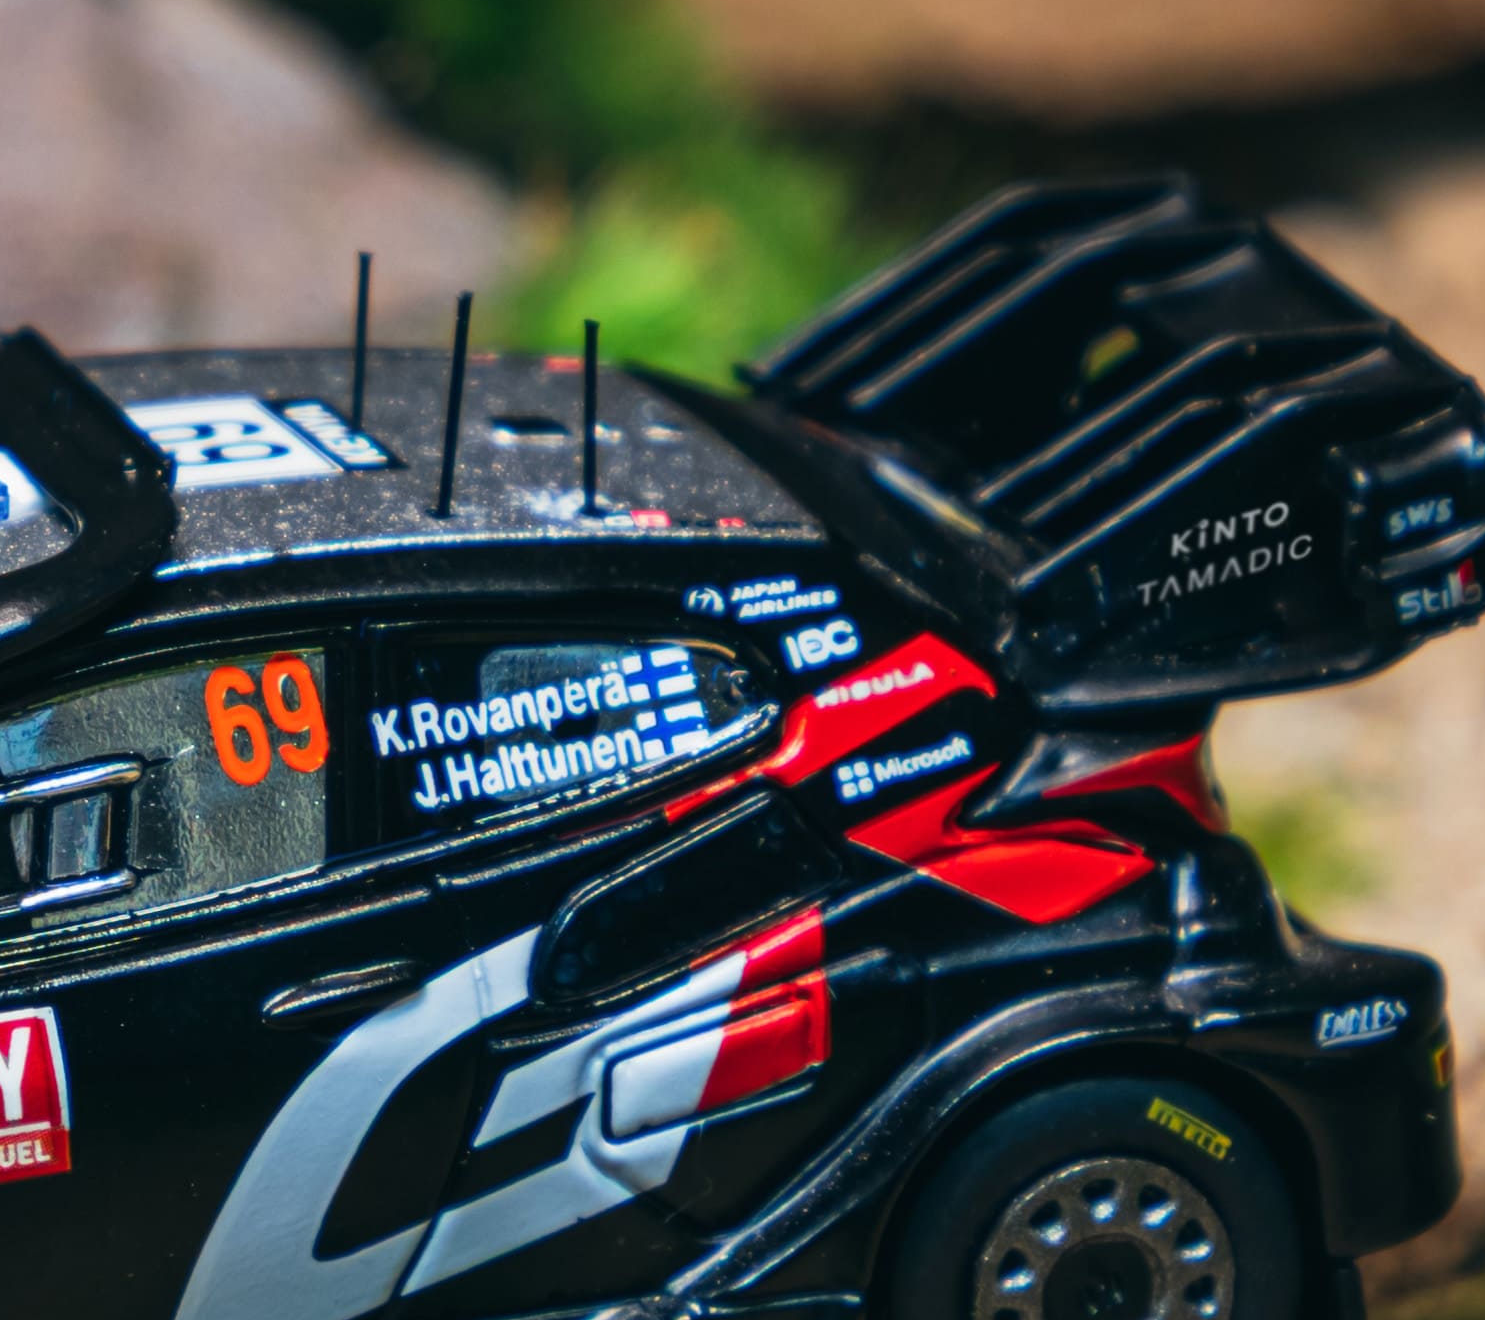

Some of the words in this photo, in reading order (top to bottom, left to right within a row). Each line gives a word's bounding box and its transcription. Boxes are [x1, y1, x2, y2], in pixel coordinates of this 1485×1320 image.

[731, 579, 797, 602] JAPAN
[739, 589, 837, 618] AIRLINES
[1137, 535, 1312, 607] TAMADIC
[204, 650, 330, 787] 69
[372, 661, 631, 757] K.Rovanperä
[414, 728, 644, 809] J.Halttunen
[873, 735, 971, 783] Microsoft
